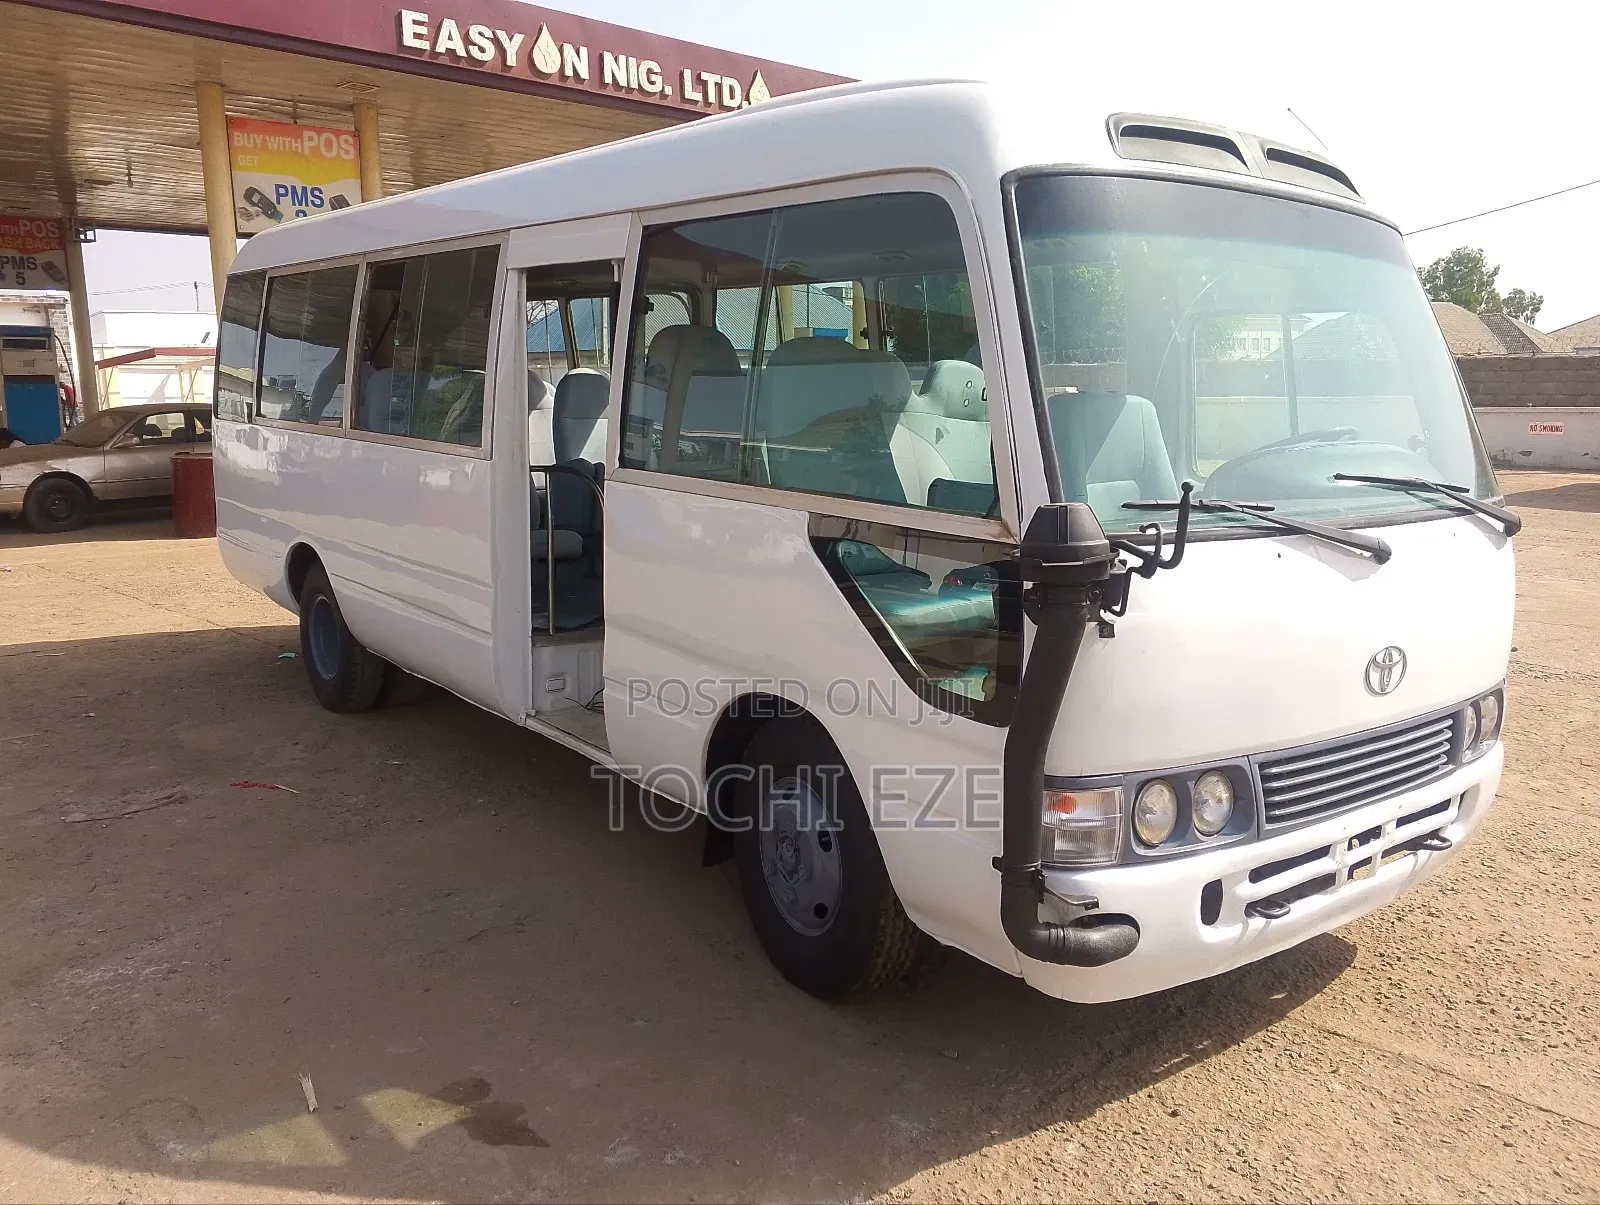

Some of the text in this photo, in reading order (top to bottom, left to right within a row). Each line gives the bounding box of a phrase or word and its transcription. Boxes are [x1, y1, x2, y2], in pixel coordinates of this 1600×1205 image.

[602, 51, 673, 96] NIG.
[233, 130, 355, 160] BUY WITH POS
[237, 155, 259, 167] GET
[274, 183, 325, 208] PMS
[0, 220, 58, 238] ITH POS
[26, 238, 59, 250] BACK
[0, 255, 38, 271] PMS
[15, 271, 26, 286] 5
